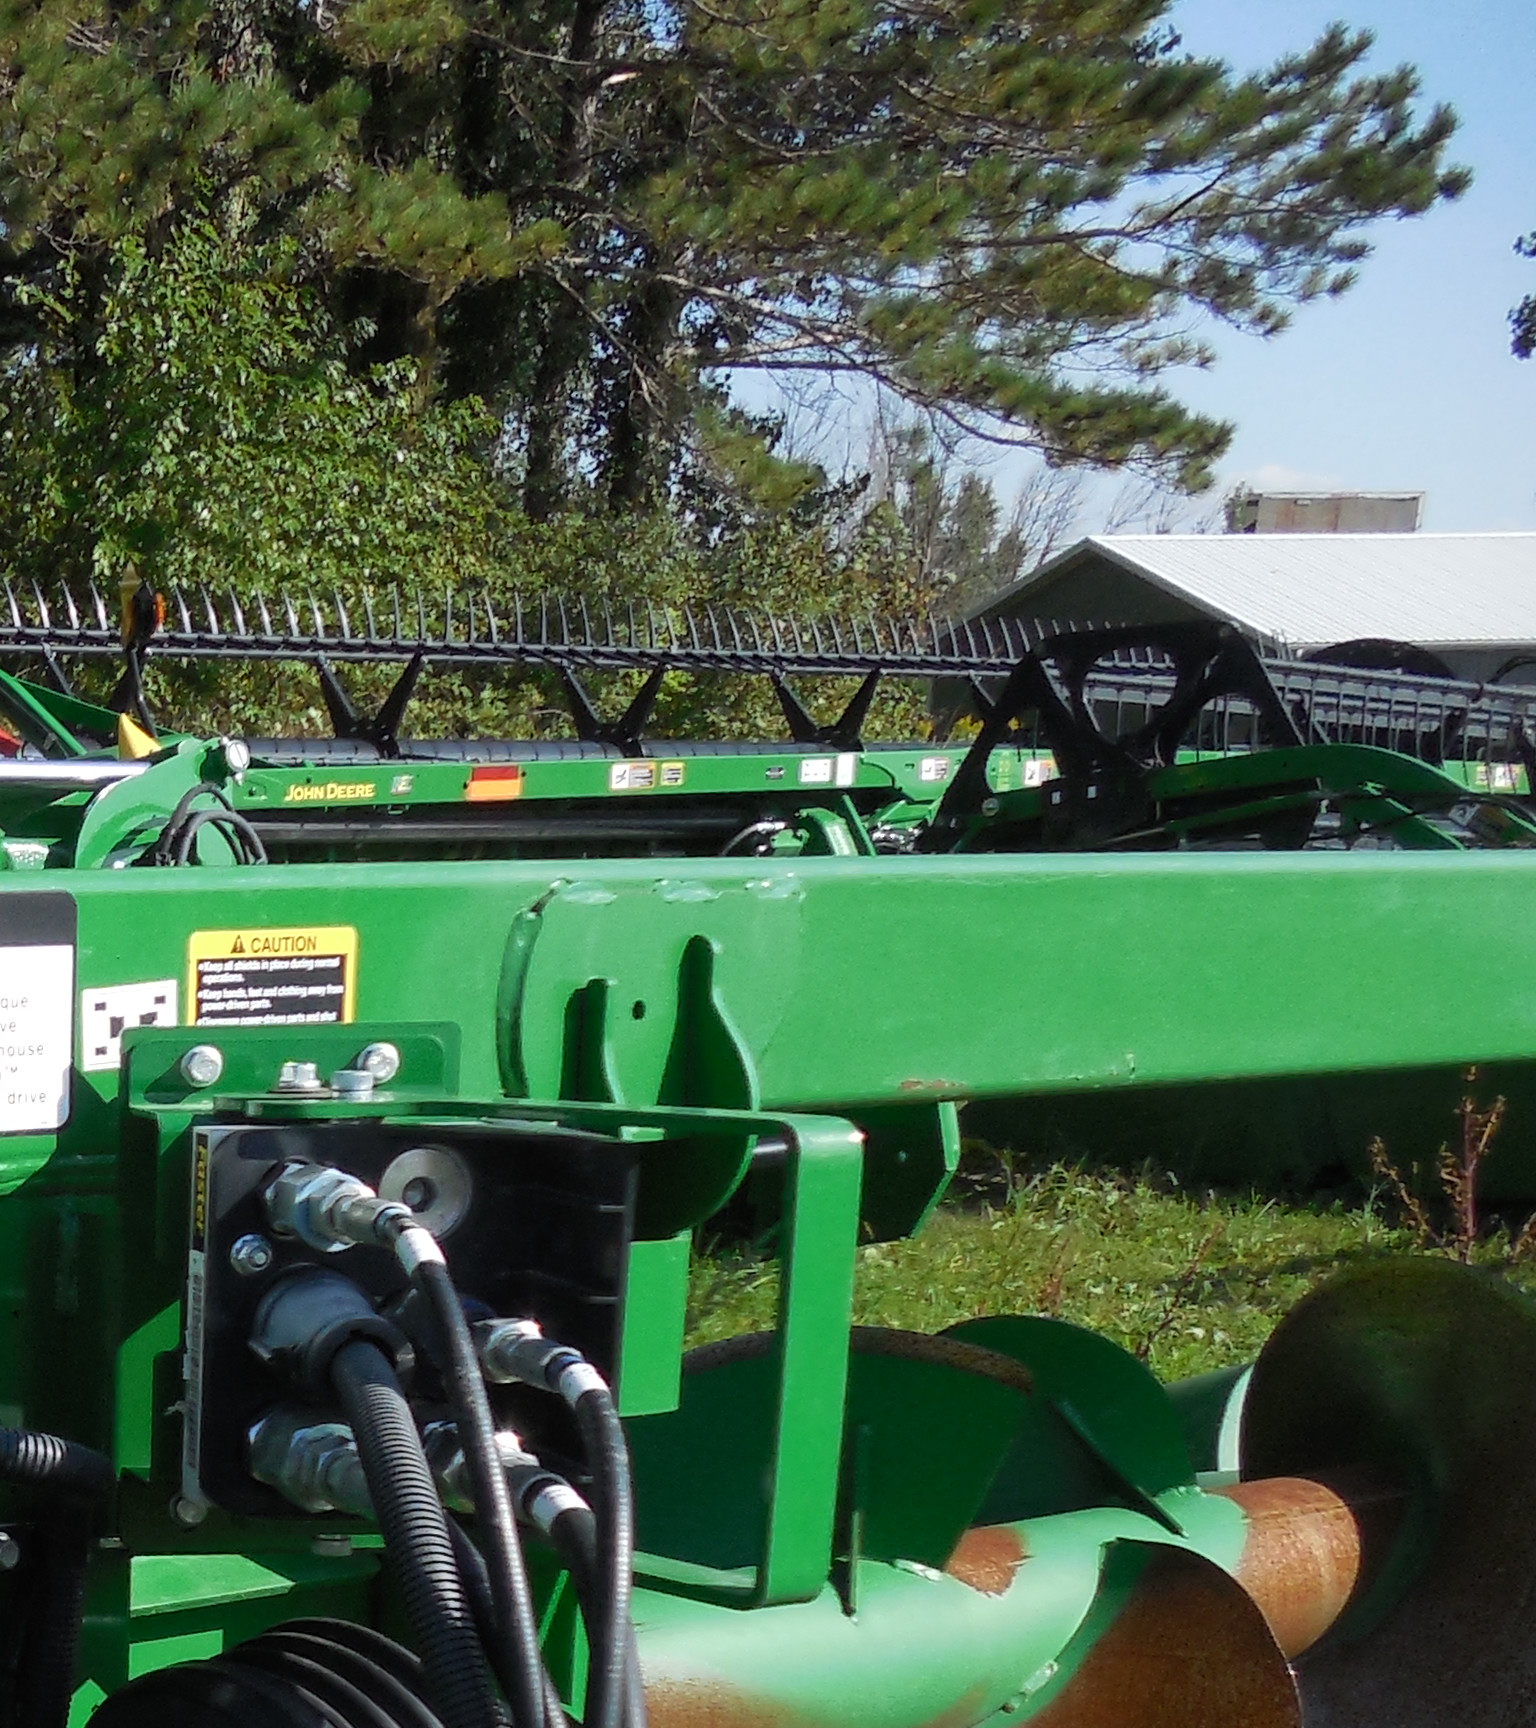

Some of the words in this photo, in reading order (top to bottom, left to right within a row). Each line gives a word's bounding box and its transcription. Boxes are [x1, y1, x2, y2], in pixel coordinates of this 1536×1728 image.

[284, 783, 325, 801] JOHN
[326, 781, 376, 799] DEERE
[250, 936, 317, 953] CAUTION
[8, 1090, 46, 1105] drive
